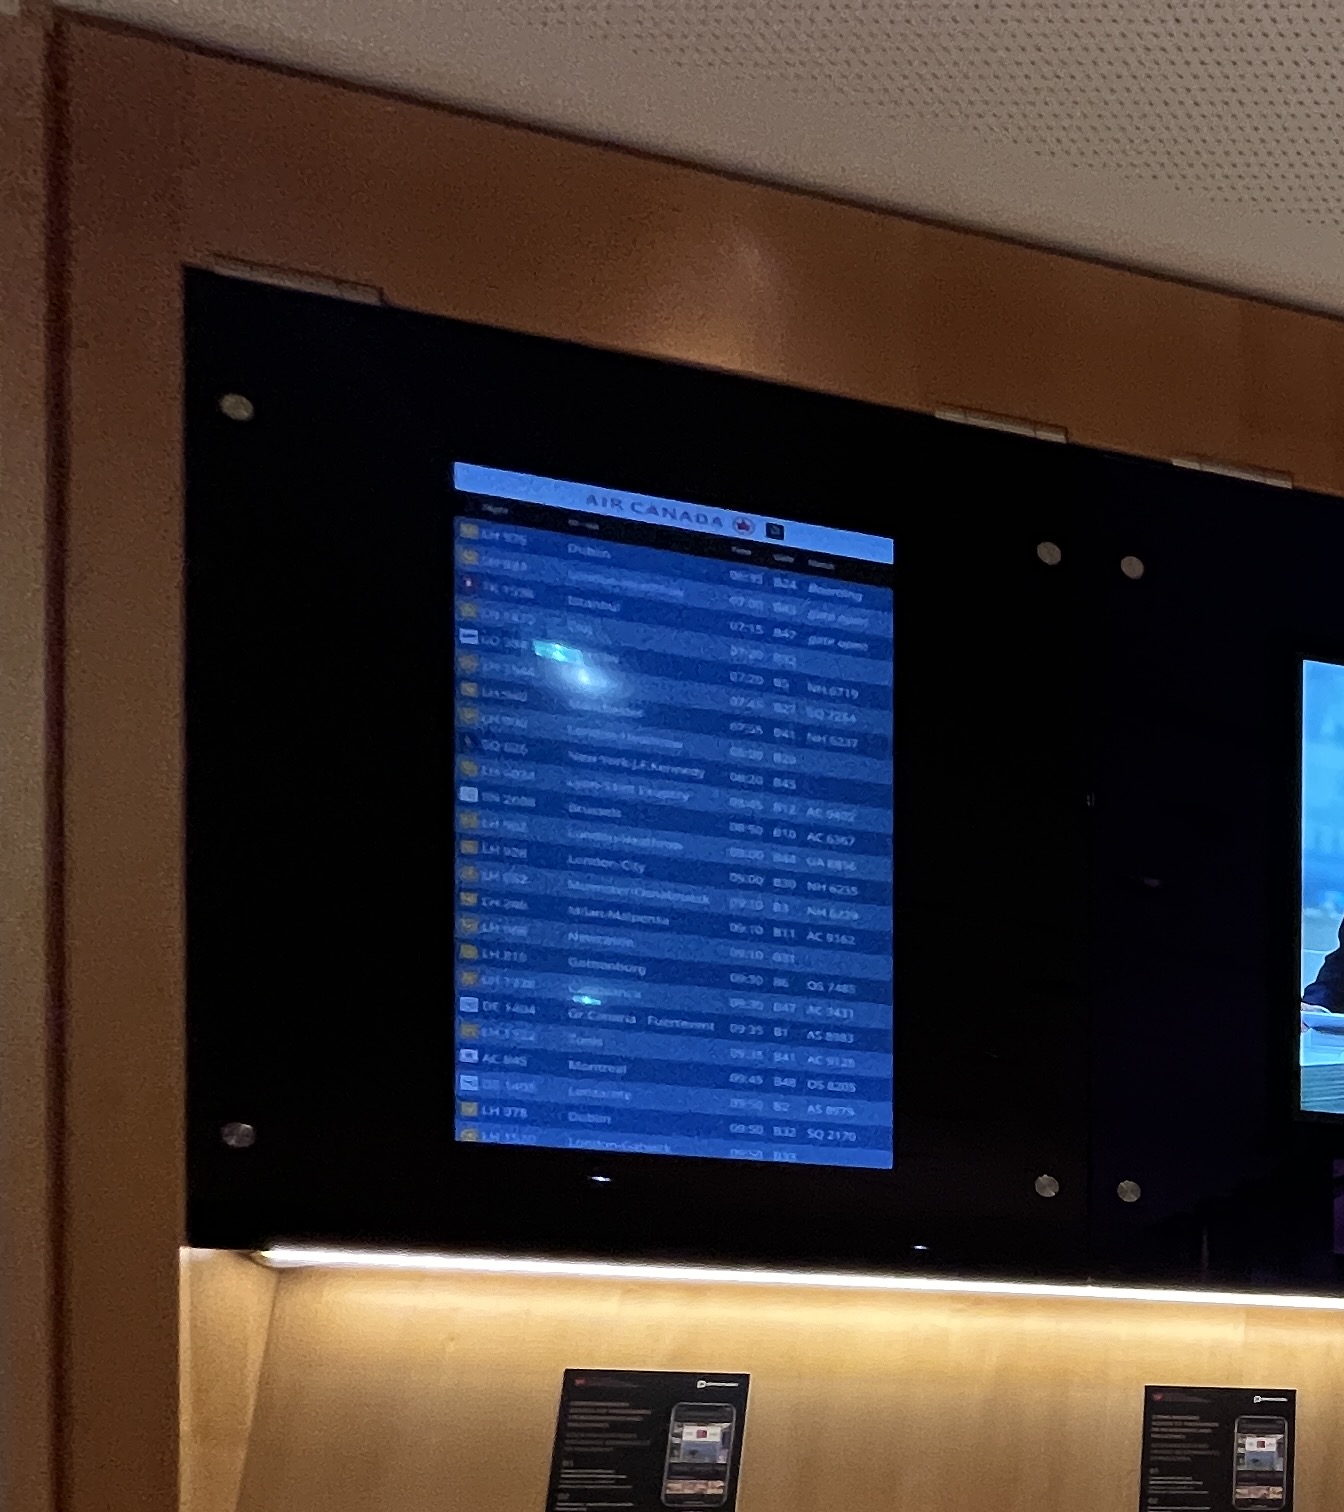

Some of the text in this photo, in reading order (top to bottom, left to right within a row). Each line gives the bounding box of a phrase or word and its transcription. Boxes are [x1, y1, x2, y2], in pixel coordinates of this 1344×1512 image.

[585, 494, 723, 528] AIR CANADA
[730, 619, 763, 635] 07:15
[807, 830, 823, 842] AC
[807, 879, 826, 892] NH
[773, 926, 795, 938] B11
[807, 929, 823, 941] AC
[807, 1103, 822, 1114] AS
[481, 1105, 498, 1117] LH
[807, 1128, 824, 1139] SQ
[827, 1129, 856, 1141] 2170
